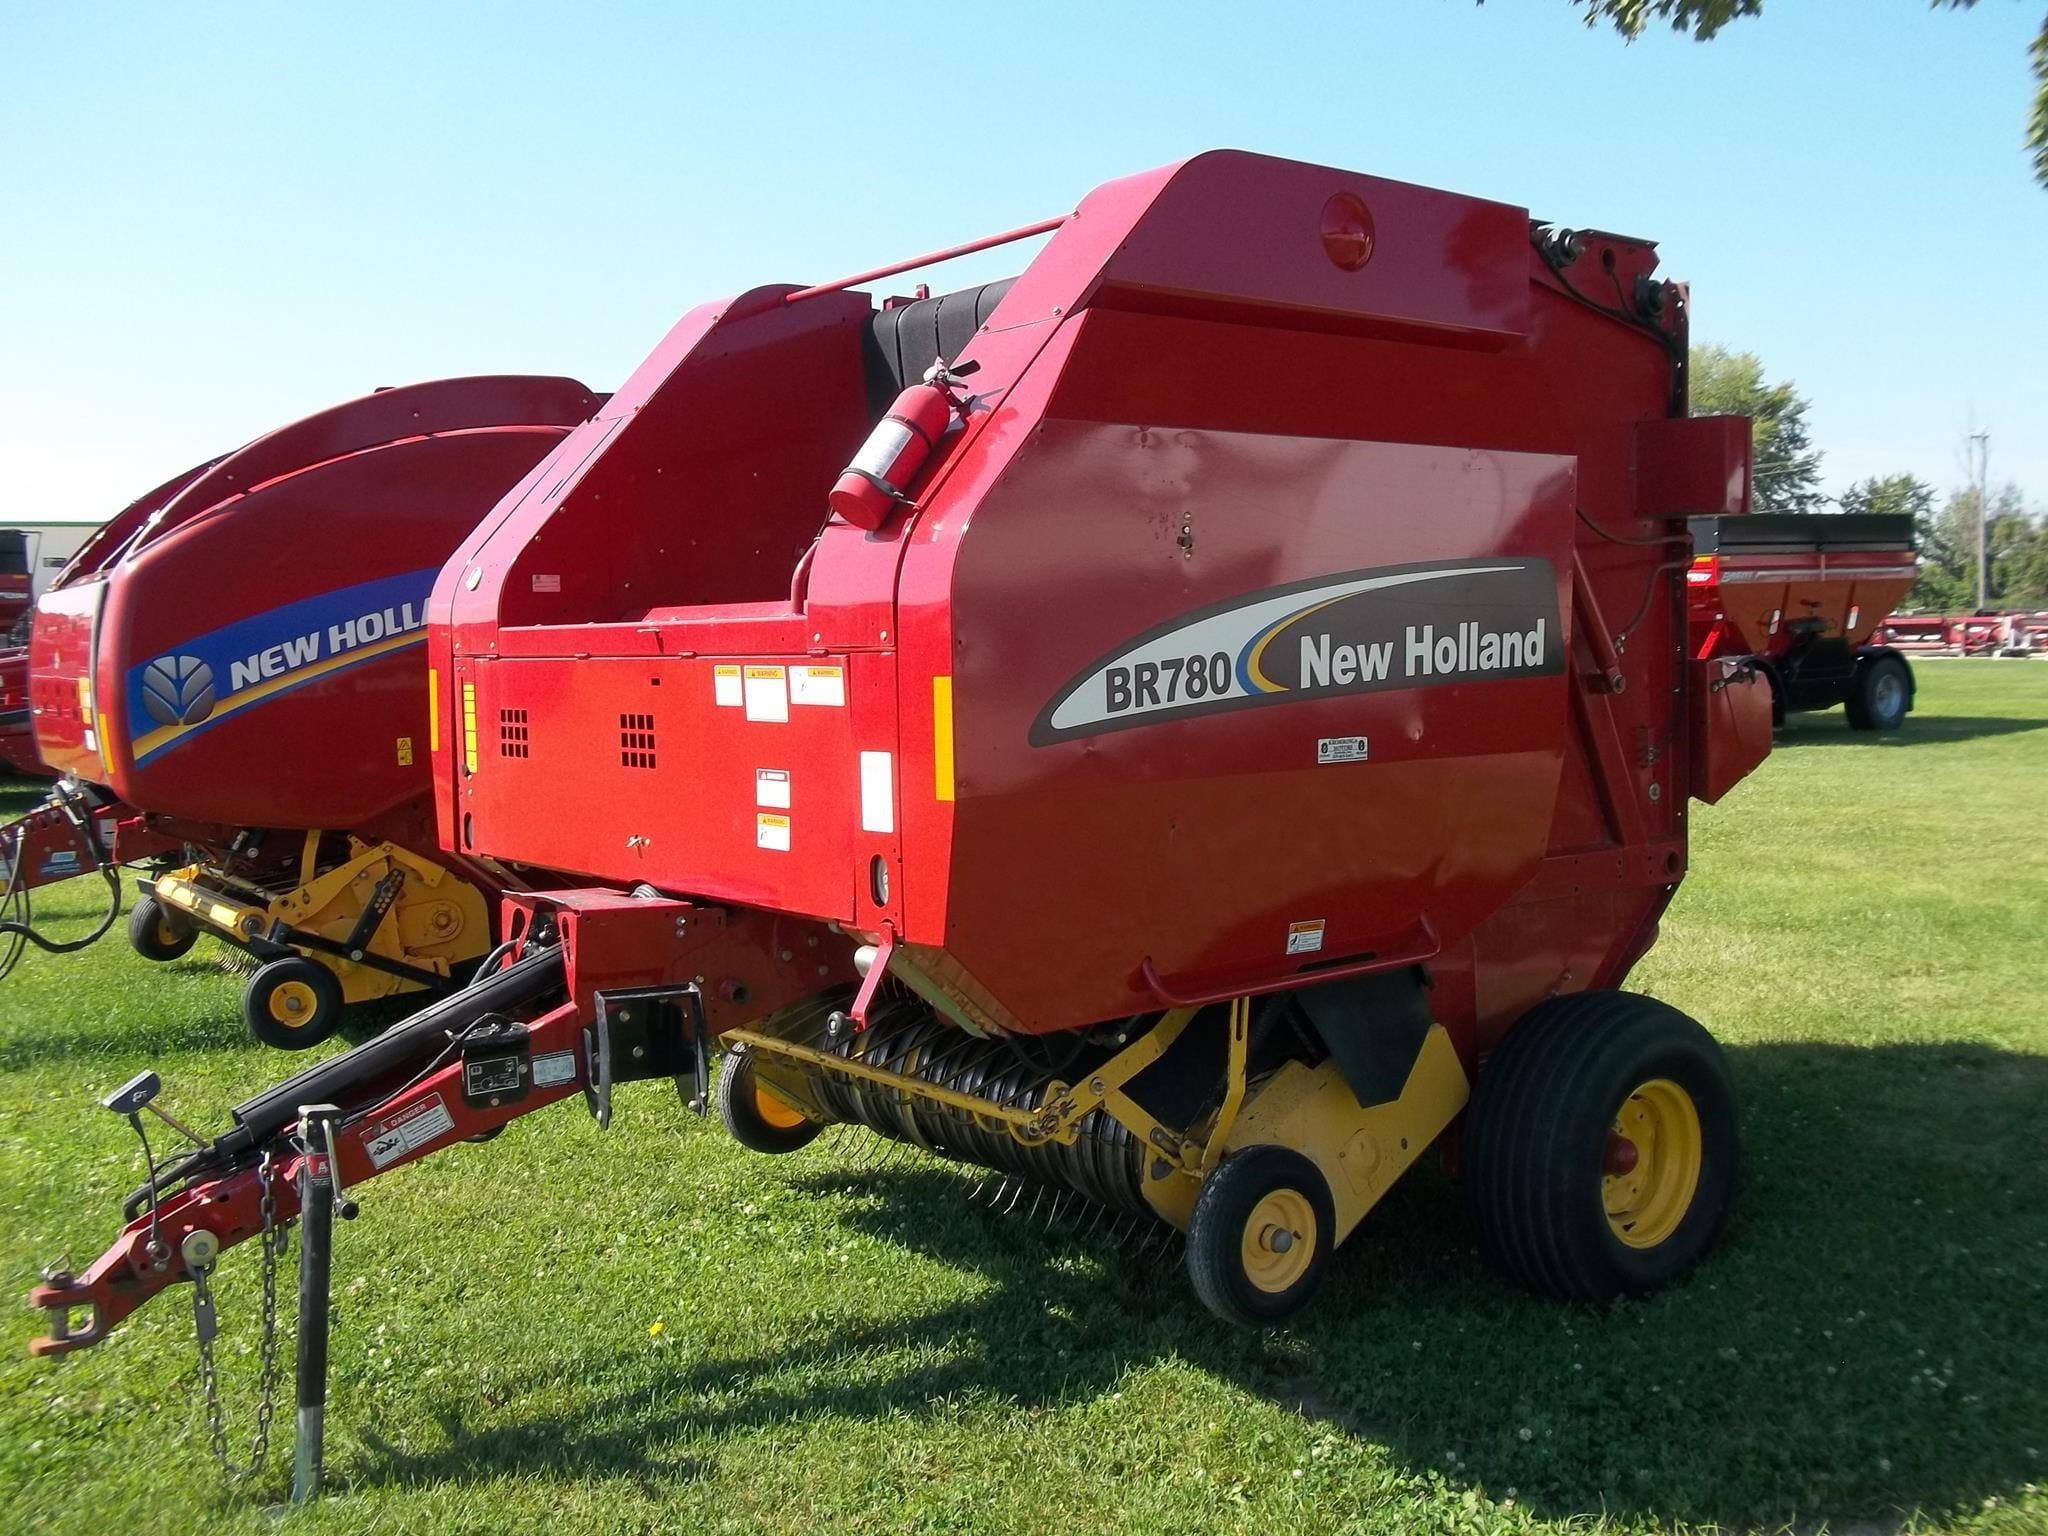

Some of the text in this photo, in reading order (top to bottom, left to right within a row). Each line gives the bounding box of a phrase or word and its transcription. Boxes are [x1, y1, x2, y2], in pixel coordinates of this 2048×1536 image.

[229, 632, 320, 691] NEW
[1107, 651, 1232, 713] BR780
[1300, 618, 1545, 690] New Holland
[391, 1104, 427, 1127] DANGER
